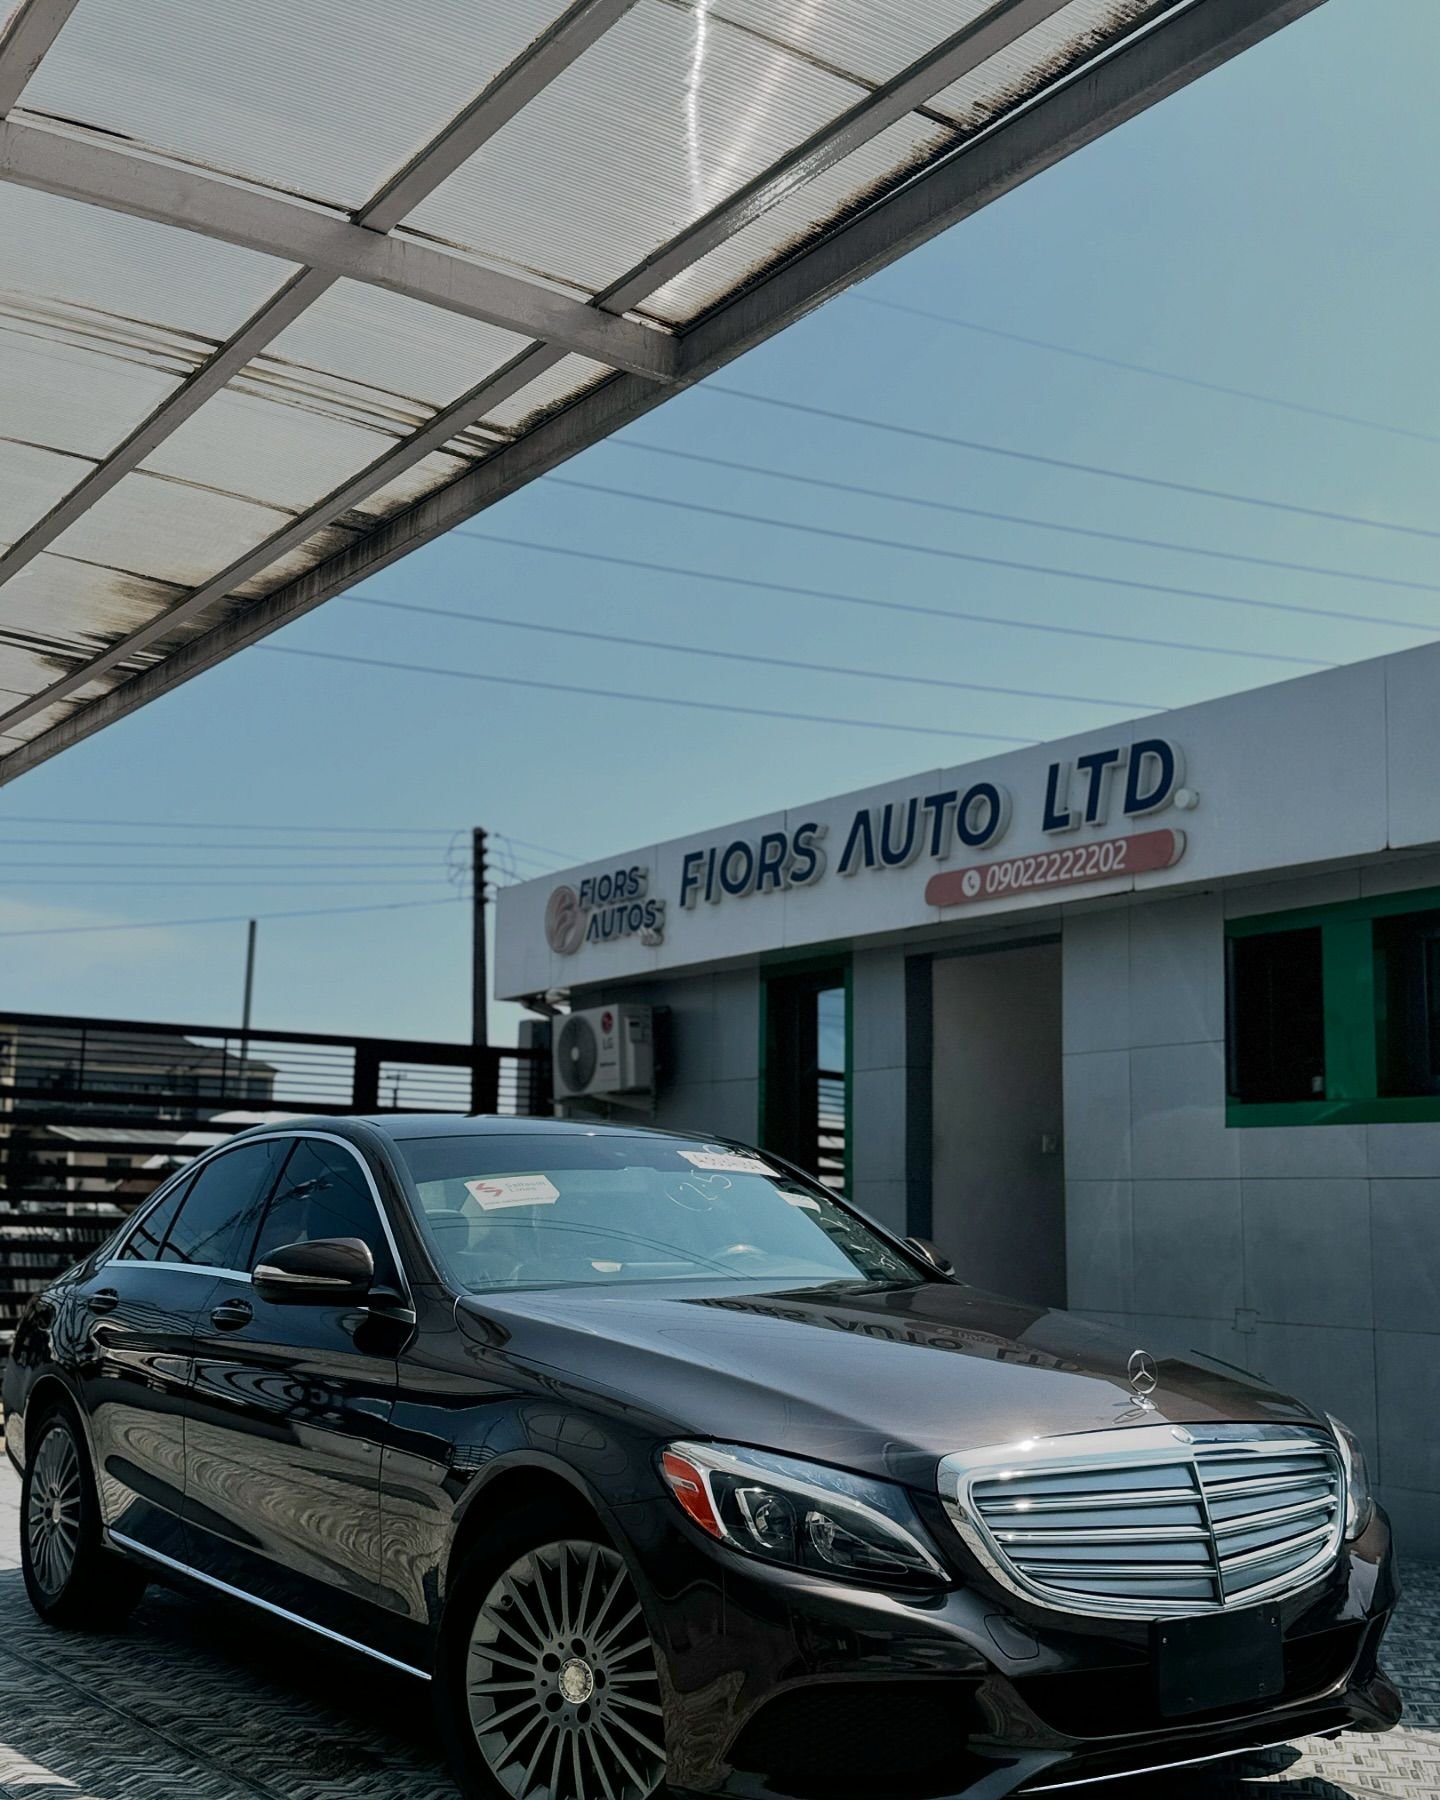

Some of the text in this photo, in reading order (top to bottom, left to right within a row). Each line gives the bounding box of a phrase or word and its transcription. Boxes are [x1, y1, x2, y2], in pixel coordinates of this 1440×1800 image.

[680, 822, 825, 907] FIORS
[837, 782, 1004, 874] AUTO
[985, 840, 1128, 893] 09022222202
[579, 865, 642, 907] FIORS
[586, 898, 660, 941] AUTOS
